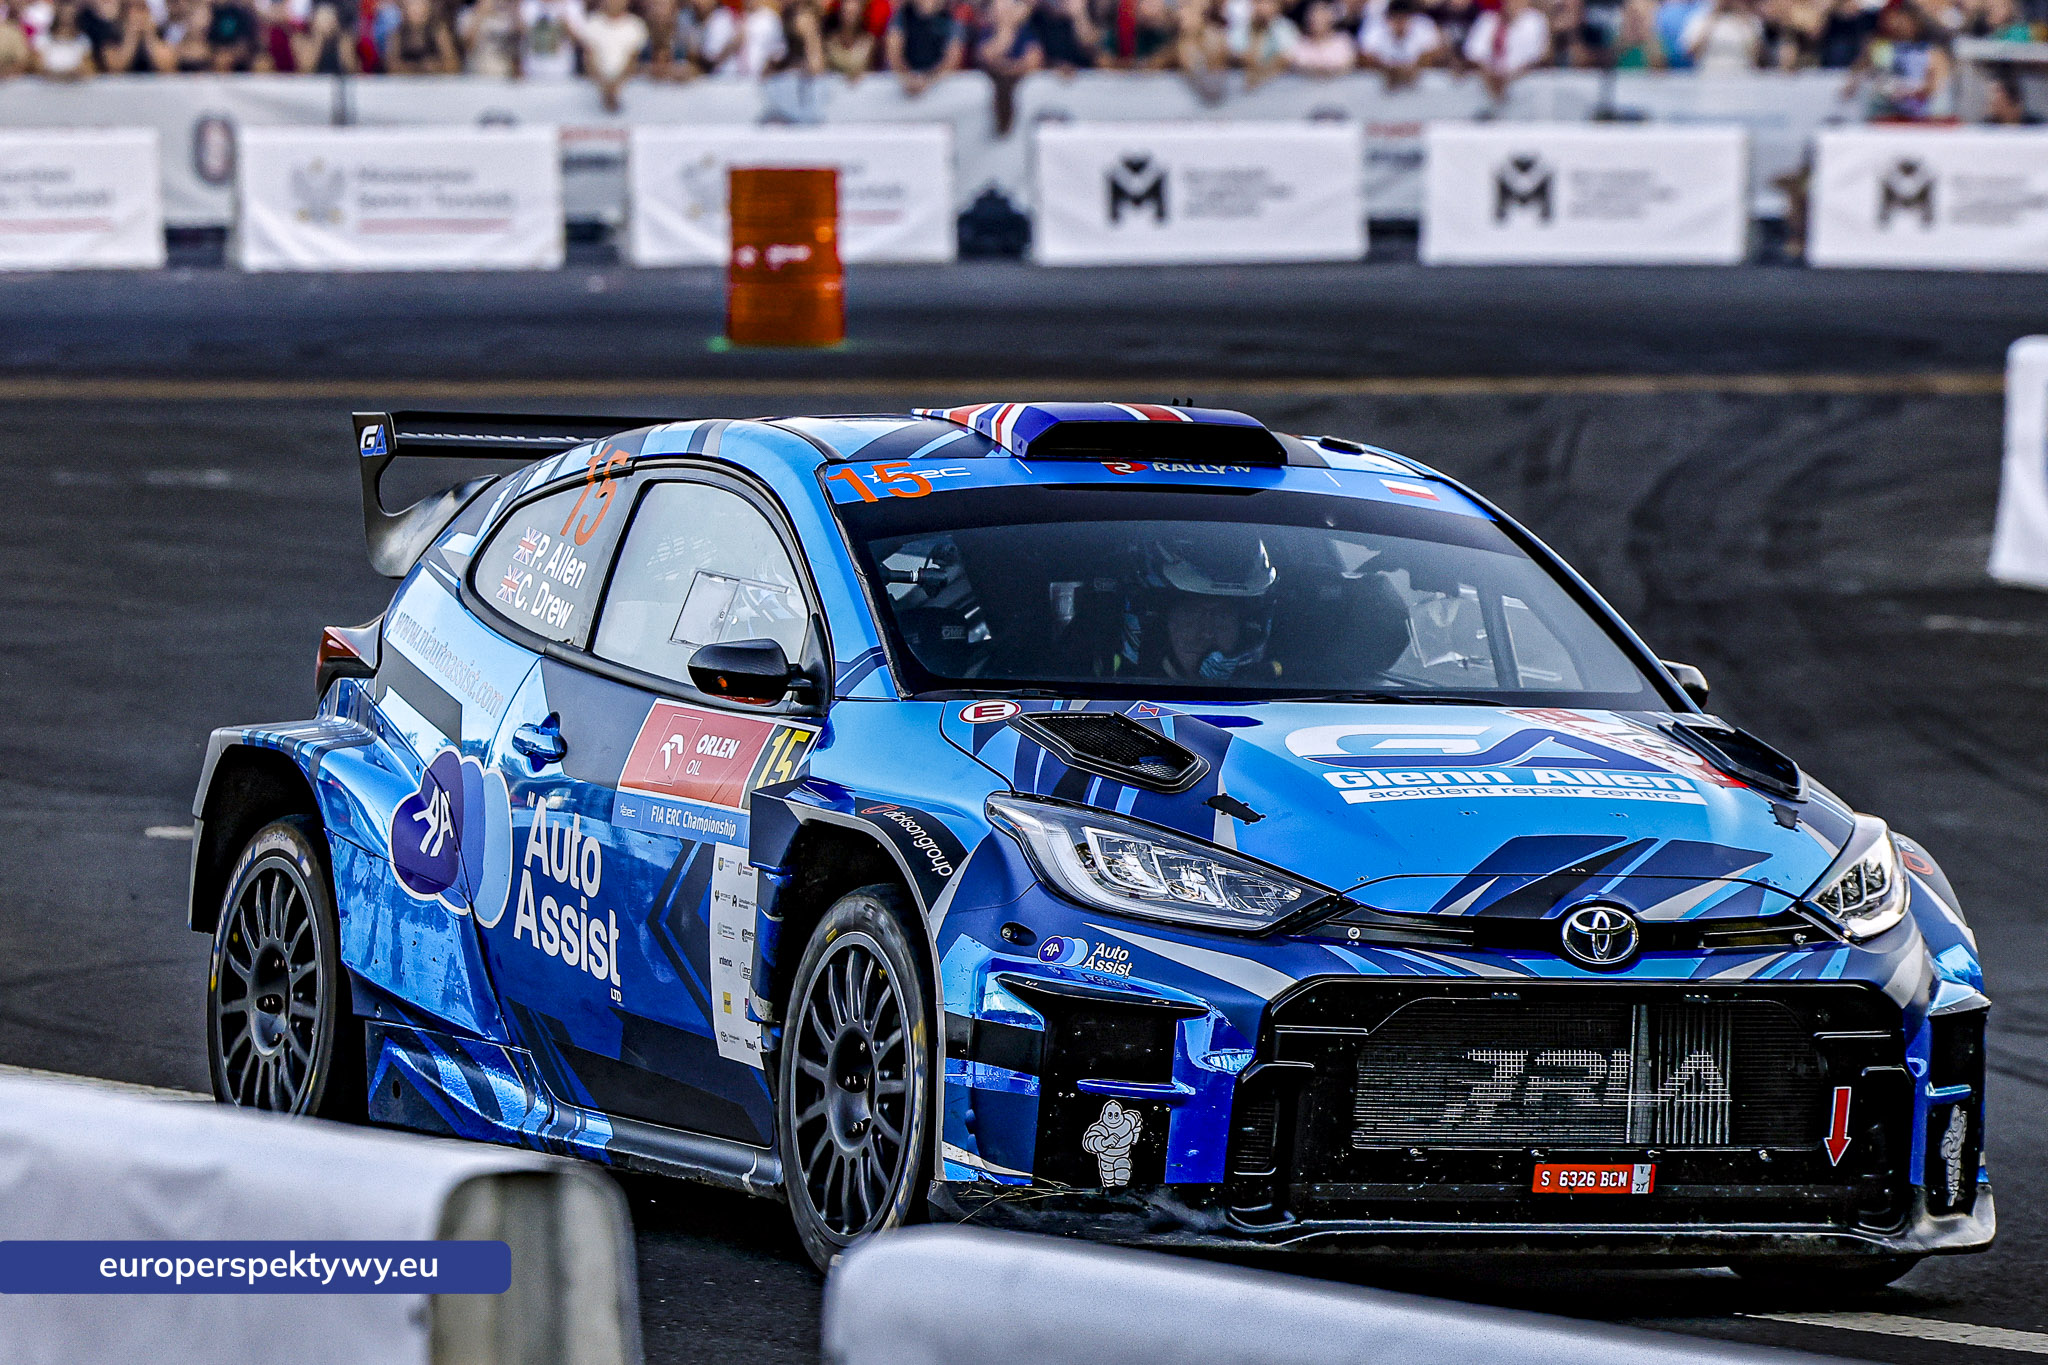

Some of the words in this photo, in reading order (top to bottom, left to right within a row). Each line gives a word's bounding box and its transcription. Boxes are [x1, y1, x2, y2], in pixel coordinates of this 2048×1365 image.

[360, 424, 387, 457] GA
[560, 444, 630, 546] 15
[827, 461, 933, 503] 15
[529, 534, 551, 572] P.
[543, 541, 588, 590] Allen
[514, 573, 533, 611] C.
[531, 579, 575, 630] Drew
[392, 610, 504, 719] www.niautoassist.com
[695, 734, 740, 760] ORLEN
[756, 727, 811, 789] 15
[686, 759, 702, 776] OIL
[1322, 770, 1514, 789] Glenn
[1531, 769, 1699, 791] Allen
[1369, 786, 1497, 799] accident
[1501, 786, 1583, 798] repair
[1591, 788, 1682, 800] centre
[650, 804, 665, 824] FIA
[665, 807, 683, 827] ERC
[682, 810, 737, 841] Championship
[524, 795, 602, 898] Auto
[513, 868, 622, 987] Assist
[1082, 955, 1133, 977] Assist
[1092, 942, 1129, 961] Auto
[610, 987, 622, 1002] LTD
[1541, 1171, 1551, 1187] S
[1559, 1171, 1596, 1187] 6326
[1600, 1171, 1628, 1187] BCM
